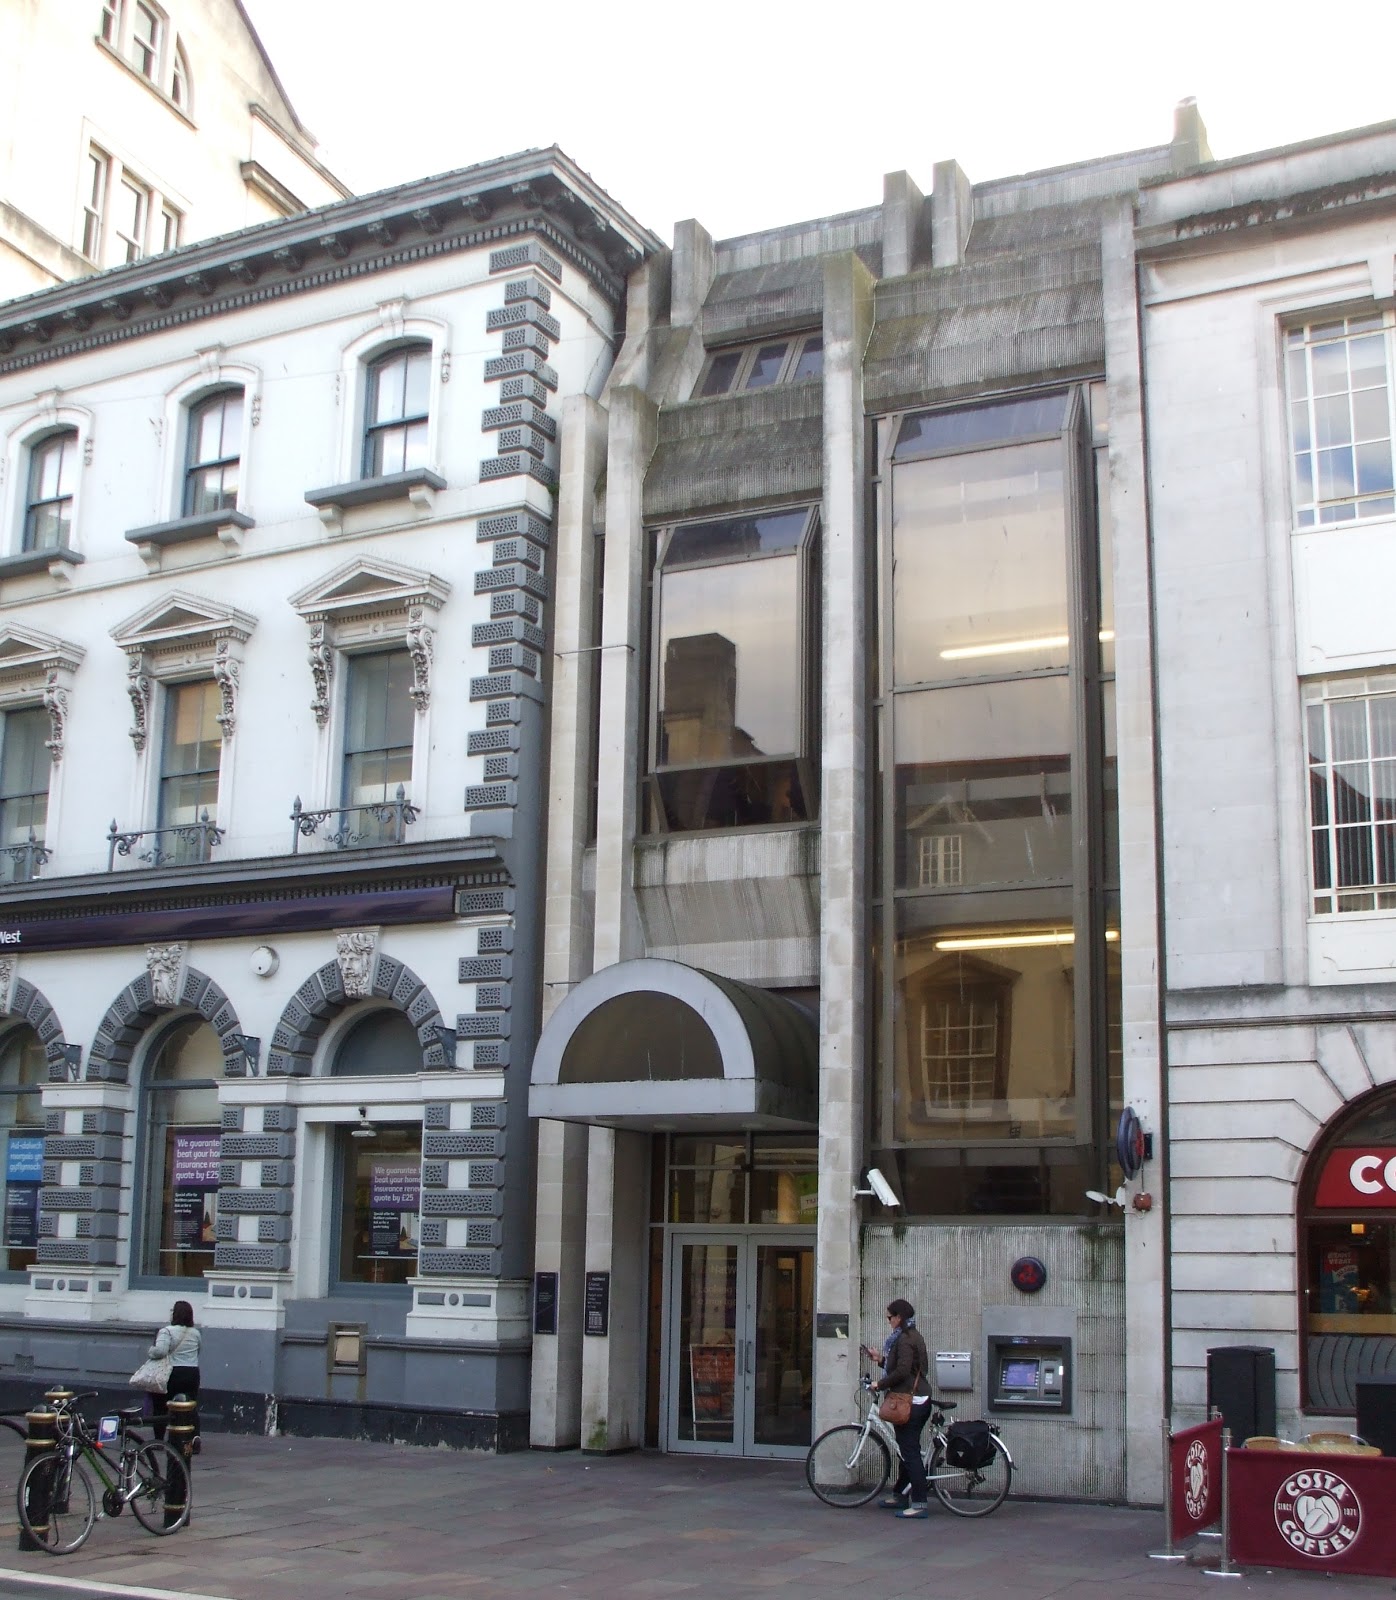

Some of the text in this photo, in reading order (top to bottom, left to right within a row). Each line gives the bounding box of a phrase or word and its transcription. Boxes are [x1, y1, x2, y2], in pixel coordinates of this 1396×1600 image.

[177, 1139, 188, 1147] We
[177, 1149, 192, 1158] beat
[193, 1151, 208, 1160] your
[176, 1160, 207, 1169] insurance
[176, 1170, 219, 1181] quote by £25
[375, 1166, 385, 1174] We
[386, 1167, 417, 1175] guarantee
[390, 1177, 404, 1185] your
[373, 1194, 414, 1204] quote by £25
[1285, 1472, 1346, 1500] COSTA
[1277, 1502, 1357, 1516] SINCE 1971
[1281, 1520, 1355, 1554] COFFEE
